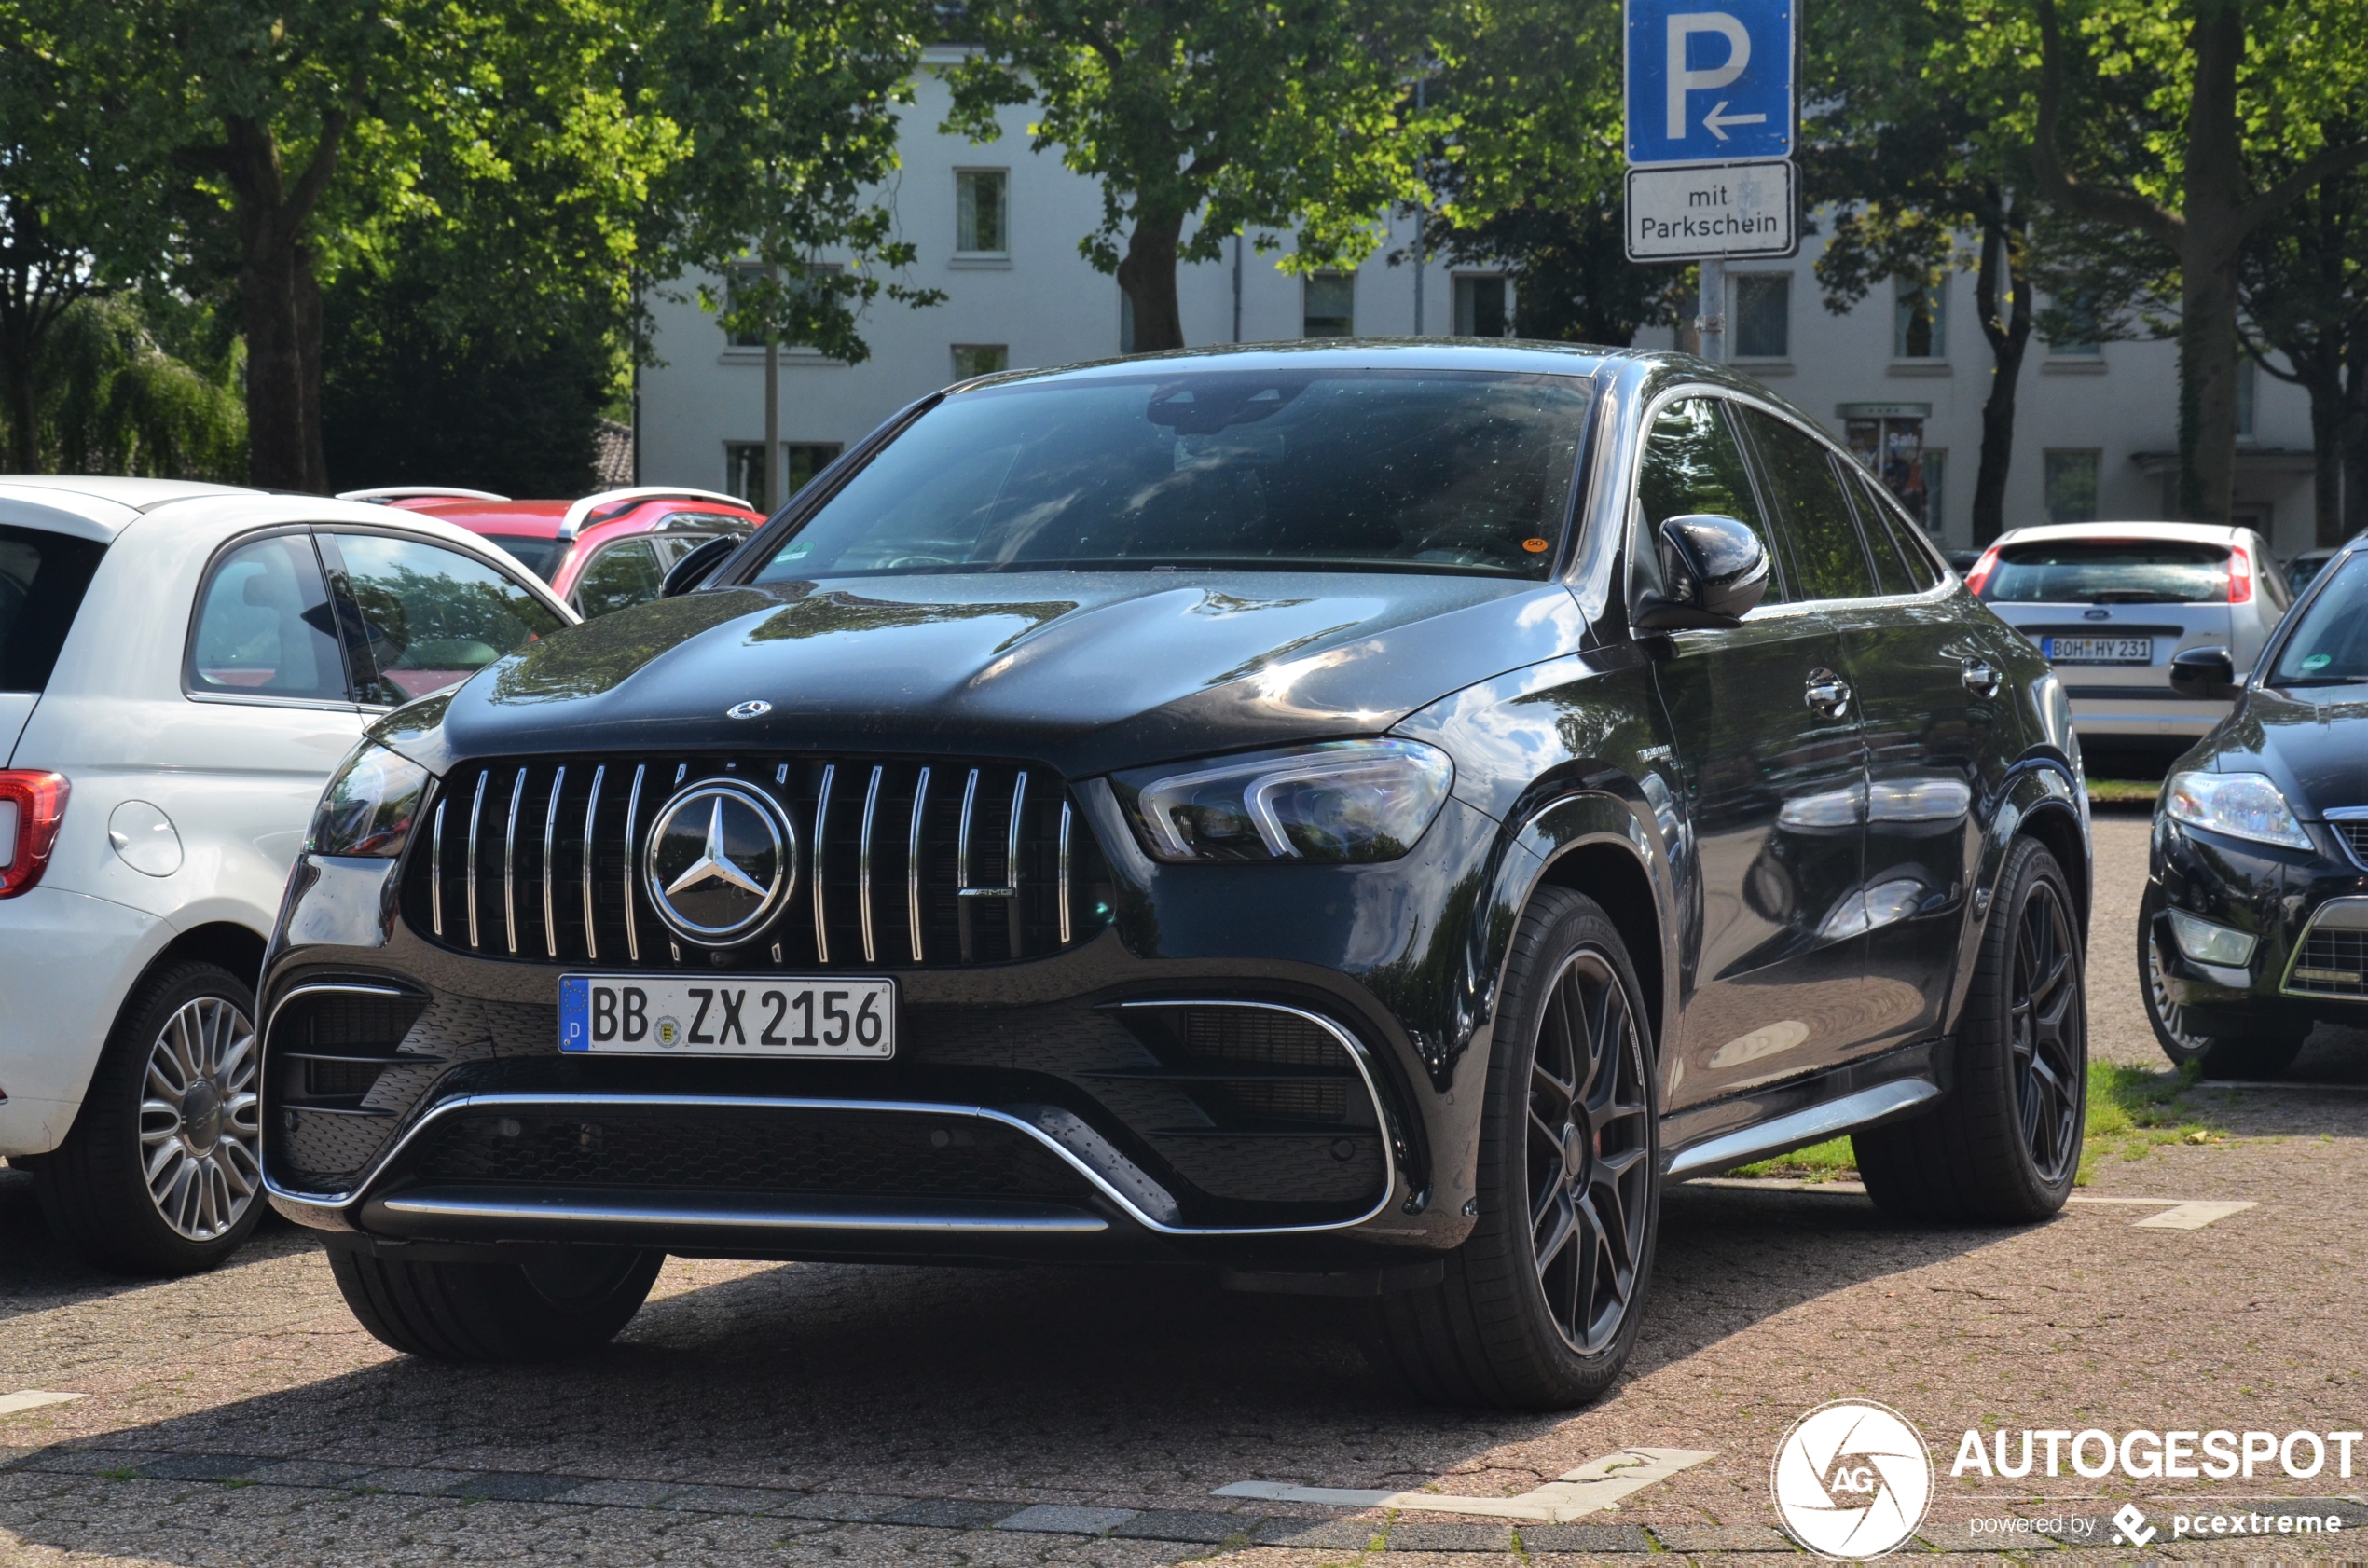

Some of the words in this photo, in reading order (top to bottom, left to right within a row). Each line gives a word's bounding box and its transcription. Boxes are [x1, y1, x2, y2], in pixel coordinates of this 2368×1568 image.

[1666, 11, 1751, 139] P
[1688, 185, 1728, 207] mit
[1640, 212, 1778, 239] Parkschein
[2053, 640, 2084, 656] BOH
[2095, 640, 2115, 656] HY
[2119, 640, 2148, 657] 231
[591, 986, 649, 1043] BB
[687, 988, 746, 1046] ZX
[760, 989, 883, 1048] 2156
[569, 1022, 581, 1038] D
